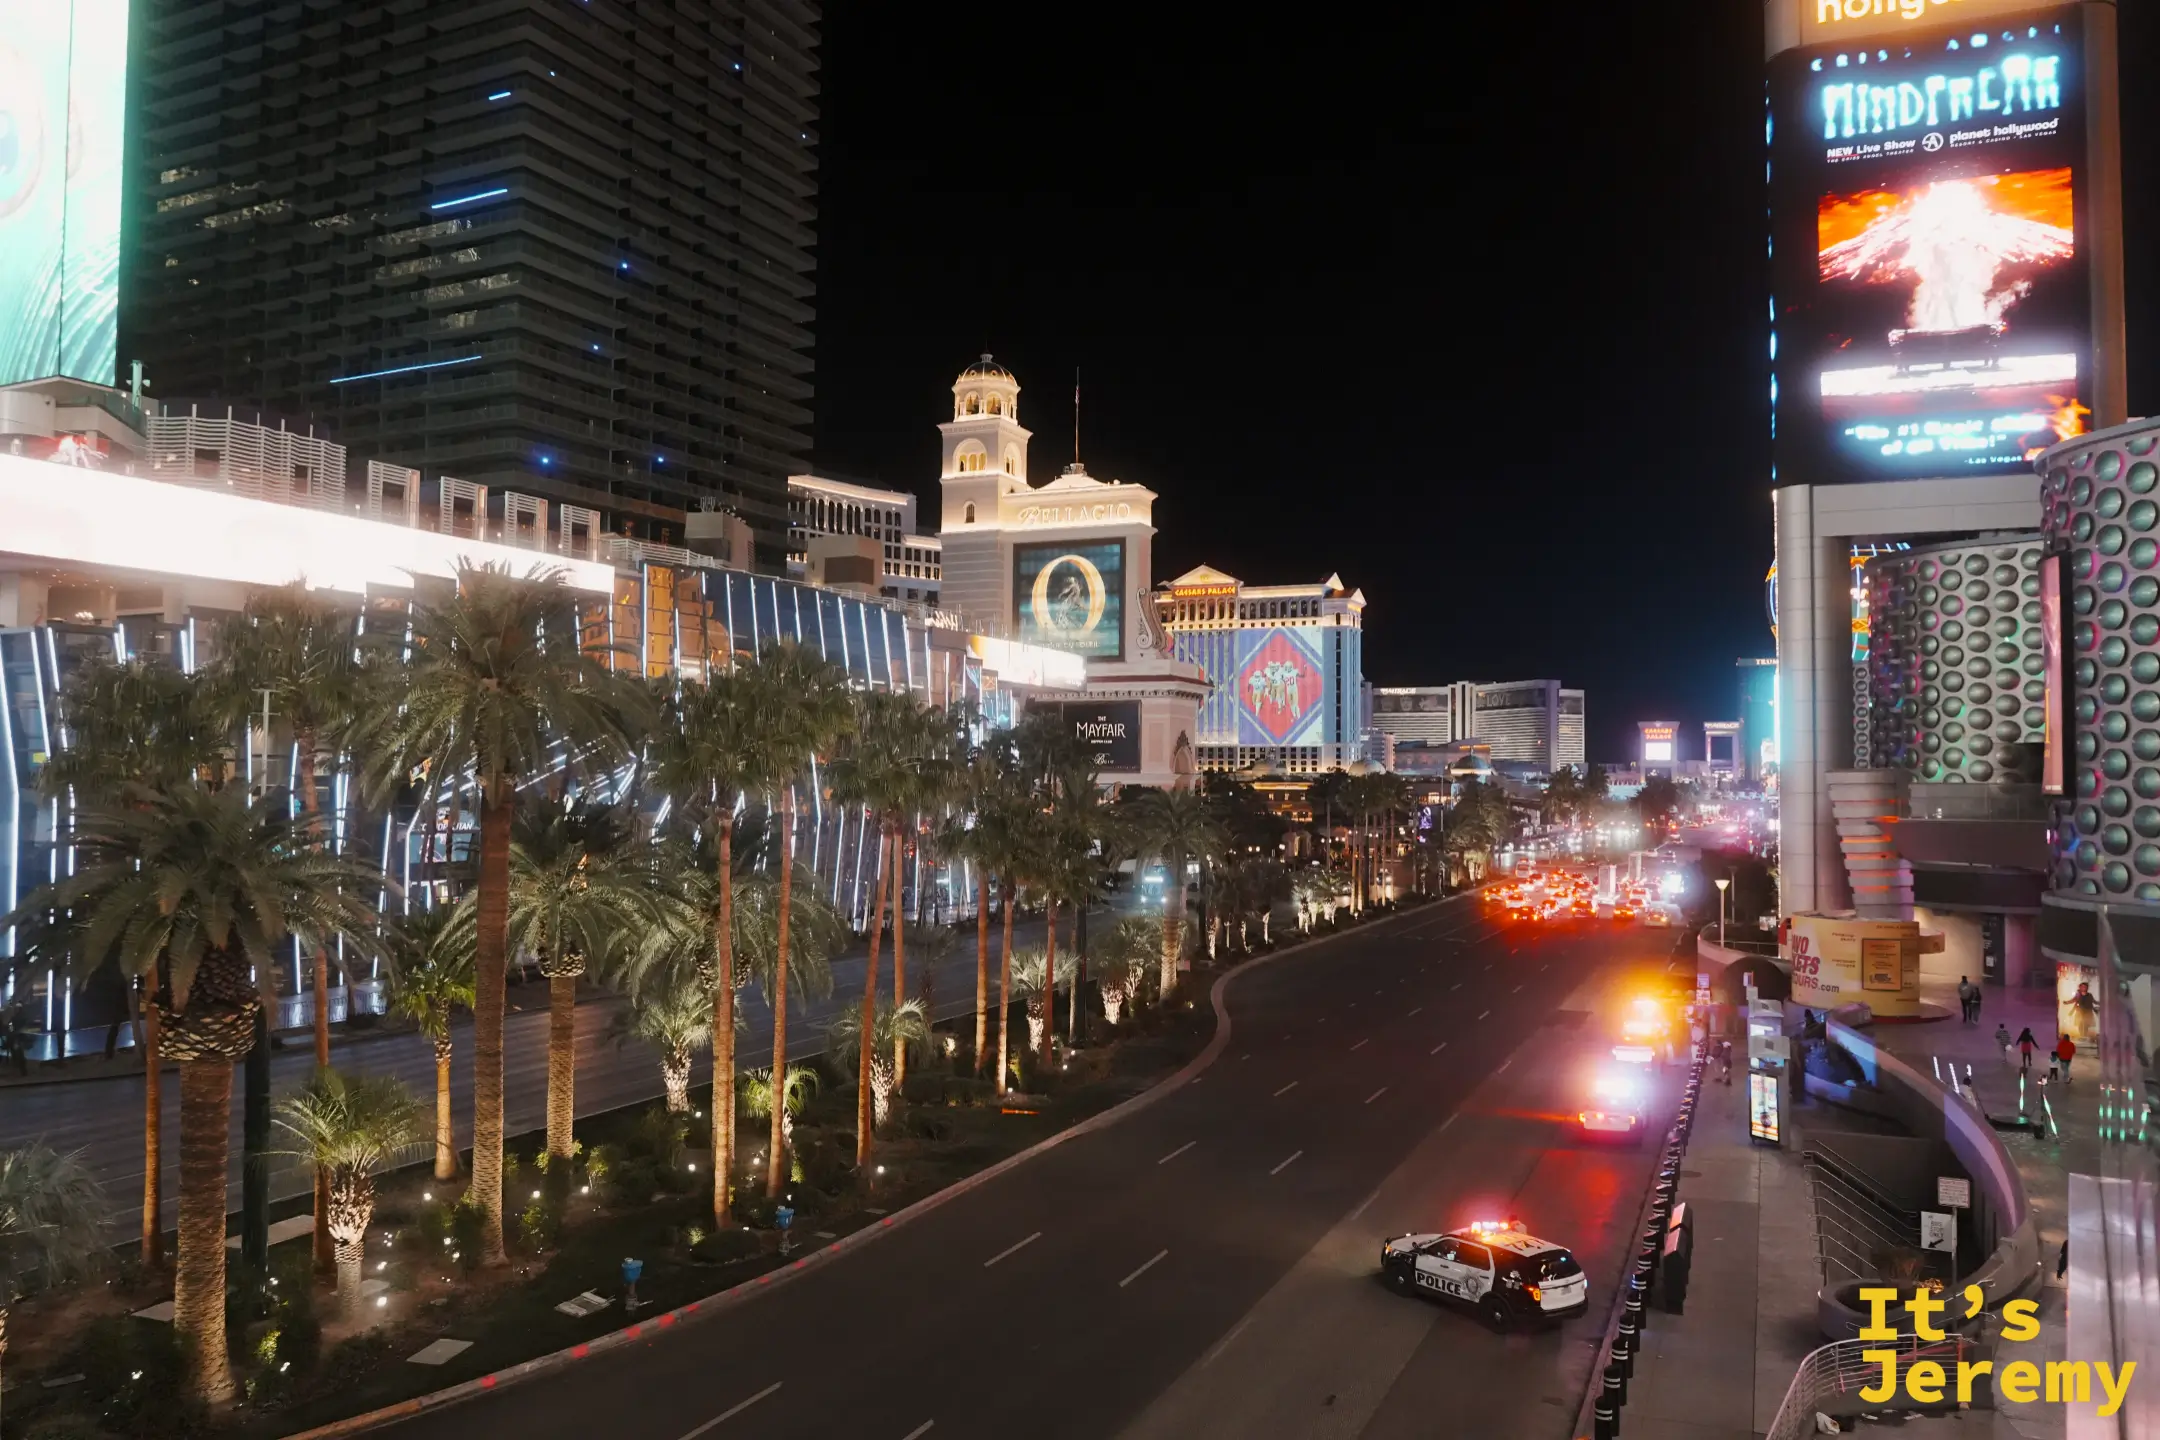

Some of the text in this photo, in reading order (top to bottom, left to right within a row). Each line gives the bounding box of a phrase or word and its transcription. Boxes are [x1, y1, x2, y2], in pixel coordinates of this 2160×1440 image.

[1949, 117, 2061, 145] planet hollywood
[1826, 139, 1917, 158] NEW Live Show
[1018, 502, 1131, 525] BELLAGIO
[1174, 586, 1236, 596] CAESARS PALACE
[1486, 693, 1512, 707] LOVE
[1076, 721, 1127, 739] MAYFAIR
[1416, 1271, 1461, 1295] POLICE
